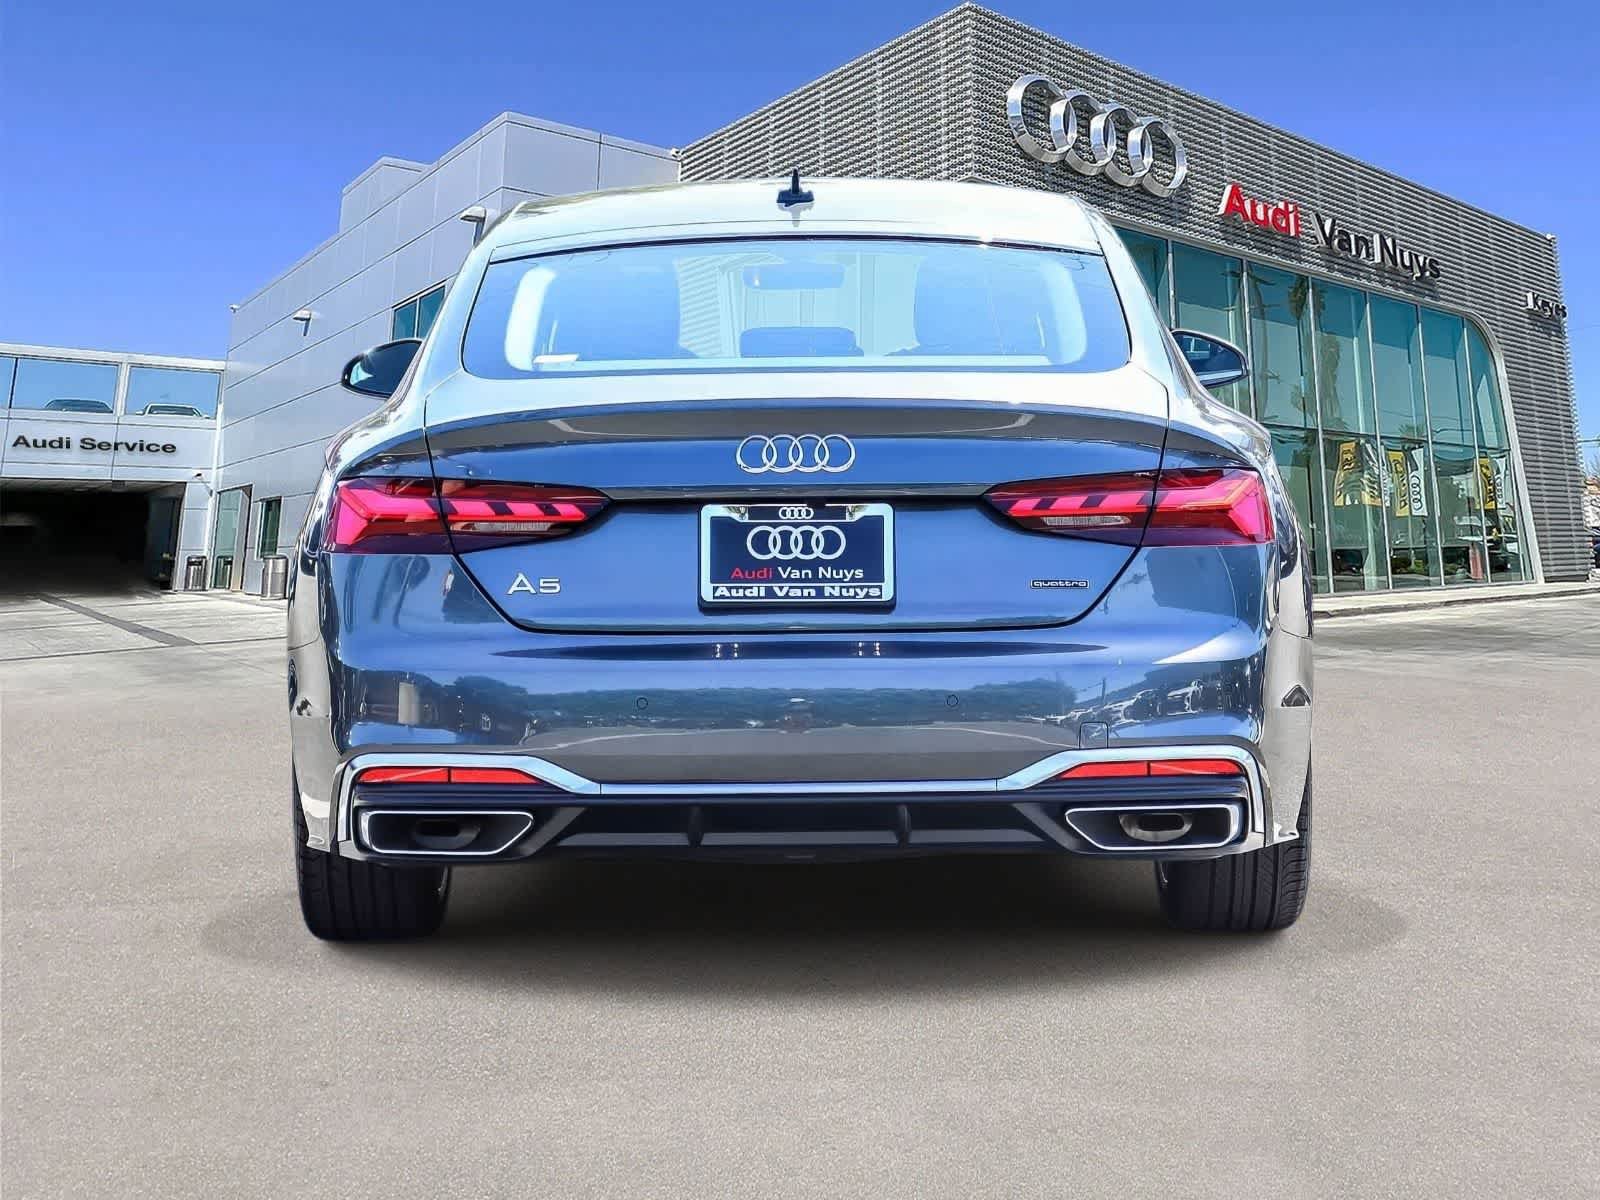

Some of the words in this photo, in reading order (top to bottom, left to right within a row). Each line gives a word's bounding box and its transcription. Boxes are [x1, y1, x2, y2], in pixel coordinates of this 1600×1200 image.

[1218, 183, 1301, 236] Audi
[1312, 213, 1371, 258] Van
[1373, 231, 1441, 280] Nuys
[12, 435, 71, 449] Audi
[79, 437, 177, 454] Service
[507, 572, 561, 595] A5
[730, 567, 773, 580] Audi
[777, 566, 813, 580] Van
[818, 566, 865, 582] Nuys
[714, 586, 766, 597] Audi
[773, 586, 817, 597] Van
[824, 585, 882, 599] Nuys
